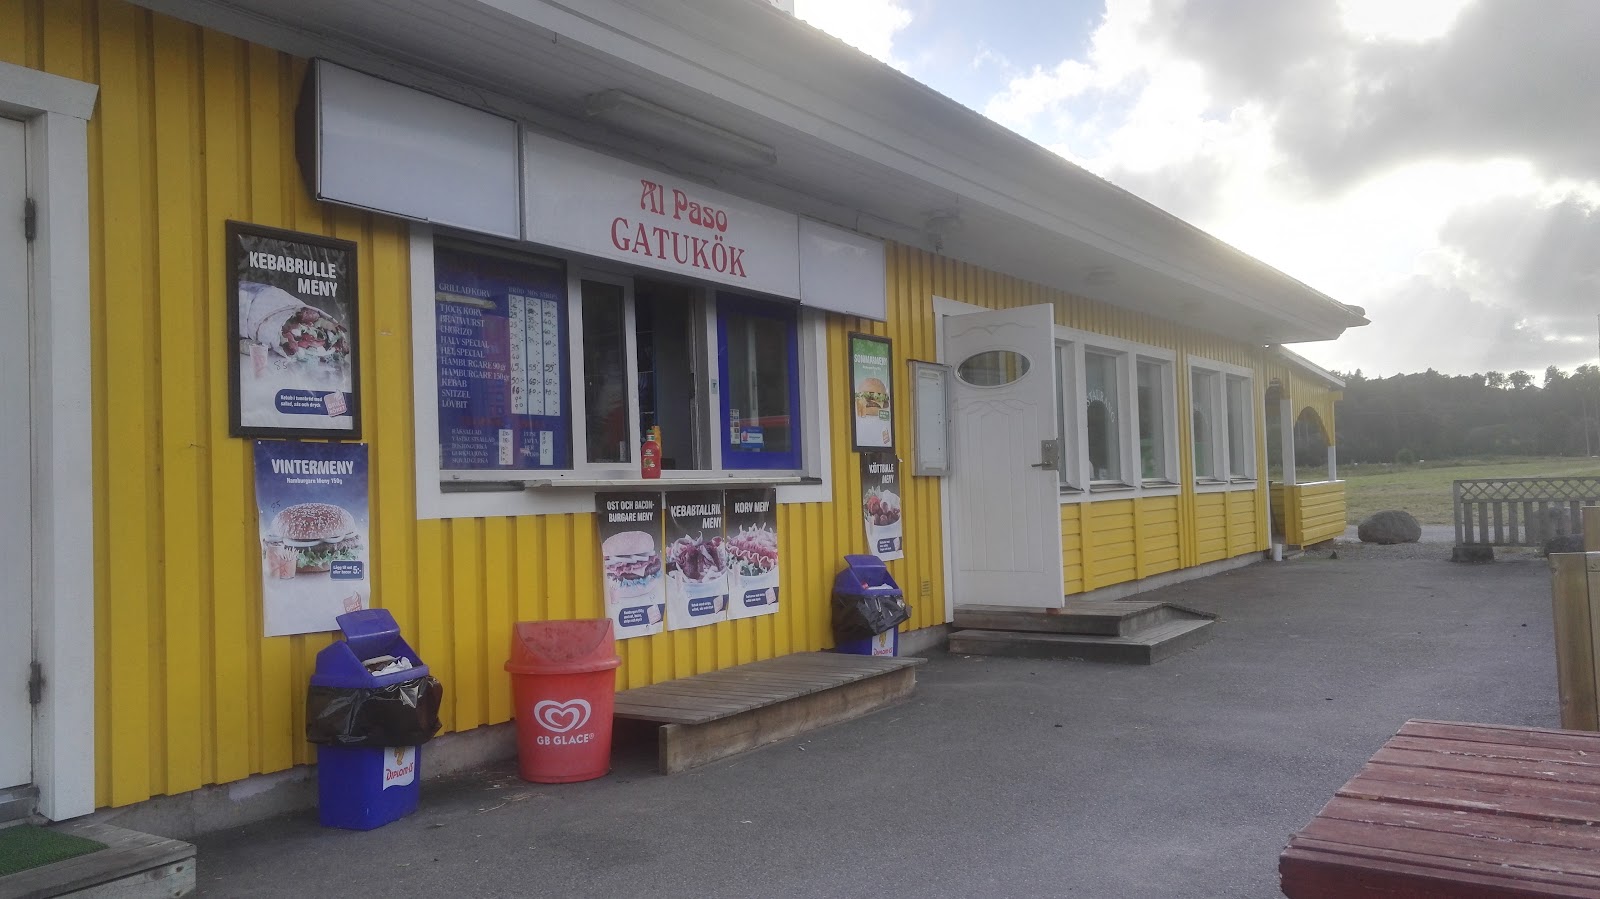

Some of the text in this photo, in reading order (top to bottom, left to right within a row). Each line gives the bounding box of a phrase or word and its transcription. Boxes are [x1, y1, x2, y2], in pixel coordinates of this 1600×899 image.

[640, 179, 728, 233] Al Paso
[611, 216, 747, 278] GATUKÖK
[249, 251, 337, 279] KEBABRULLE
[297, 277, 338, 298] MENY
[440, 315, 485, 328] BRATWURST
[440, 325, 473, 336] CHORIZO
[457, 348, 485, 359] SPECIAL
[441, 356, 492, 370] HAMBURGARE
[441, 367, 493, 380] HAMBURGARE
[441, 378, 468, 388] KEBAB
[441, 389, 471, 399] SNITZEL
[442, 397, 468, 409] LÖVBIT
[271, 458, 354, 475] VINTERMENY
[881, 474, 895, 484] MENY
[606, 500, 619, 511] OST
[620, 500, 634, 510] OCH
[670, 503, 722, 518] KEBABTALLRIK
[734, 501, 770, 514] KORV MENY
[608, 511, 654, 523] BURGARE MENY
[702, 516, 722, 529] MENY
[536, 735, 551, 746] GB
